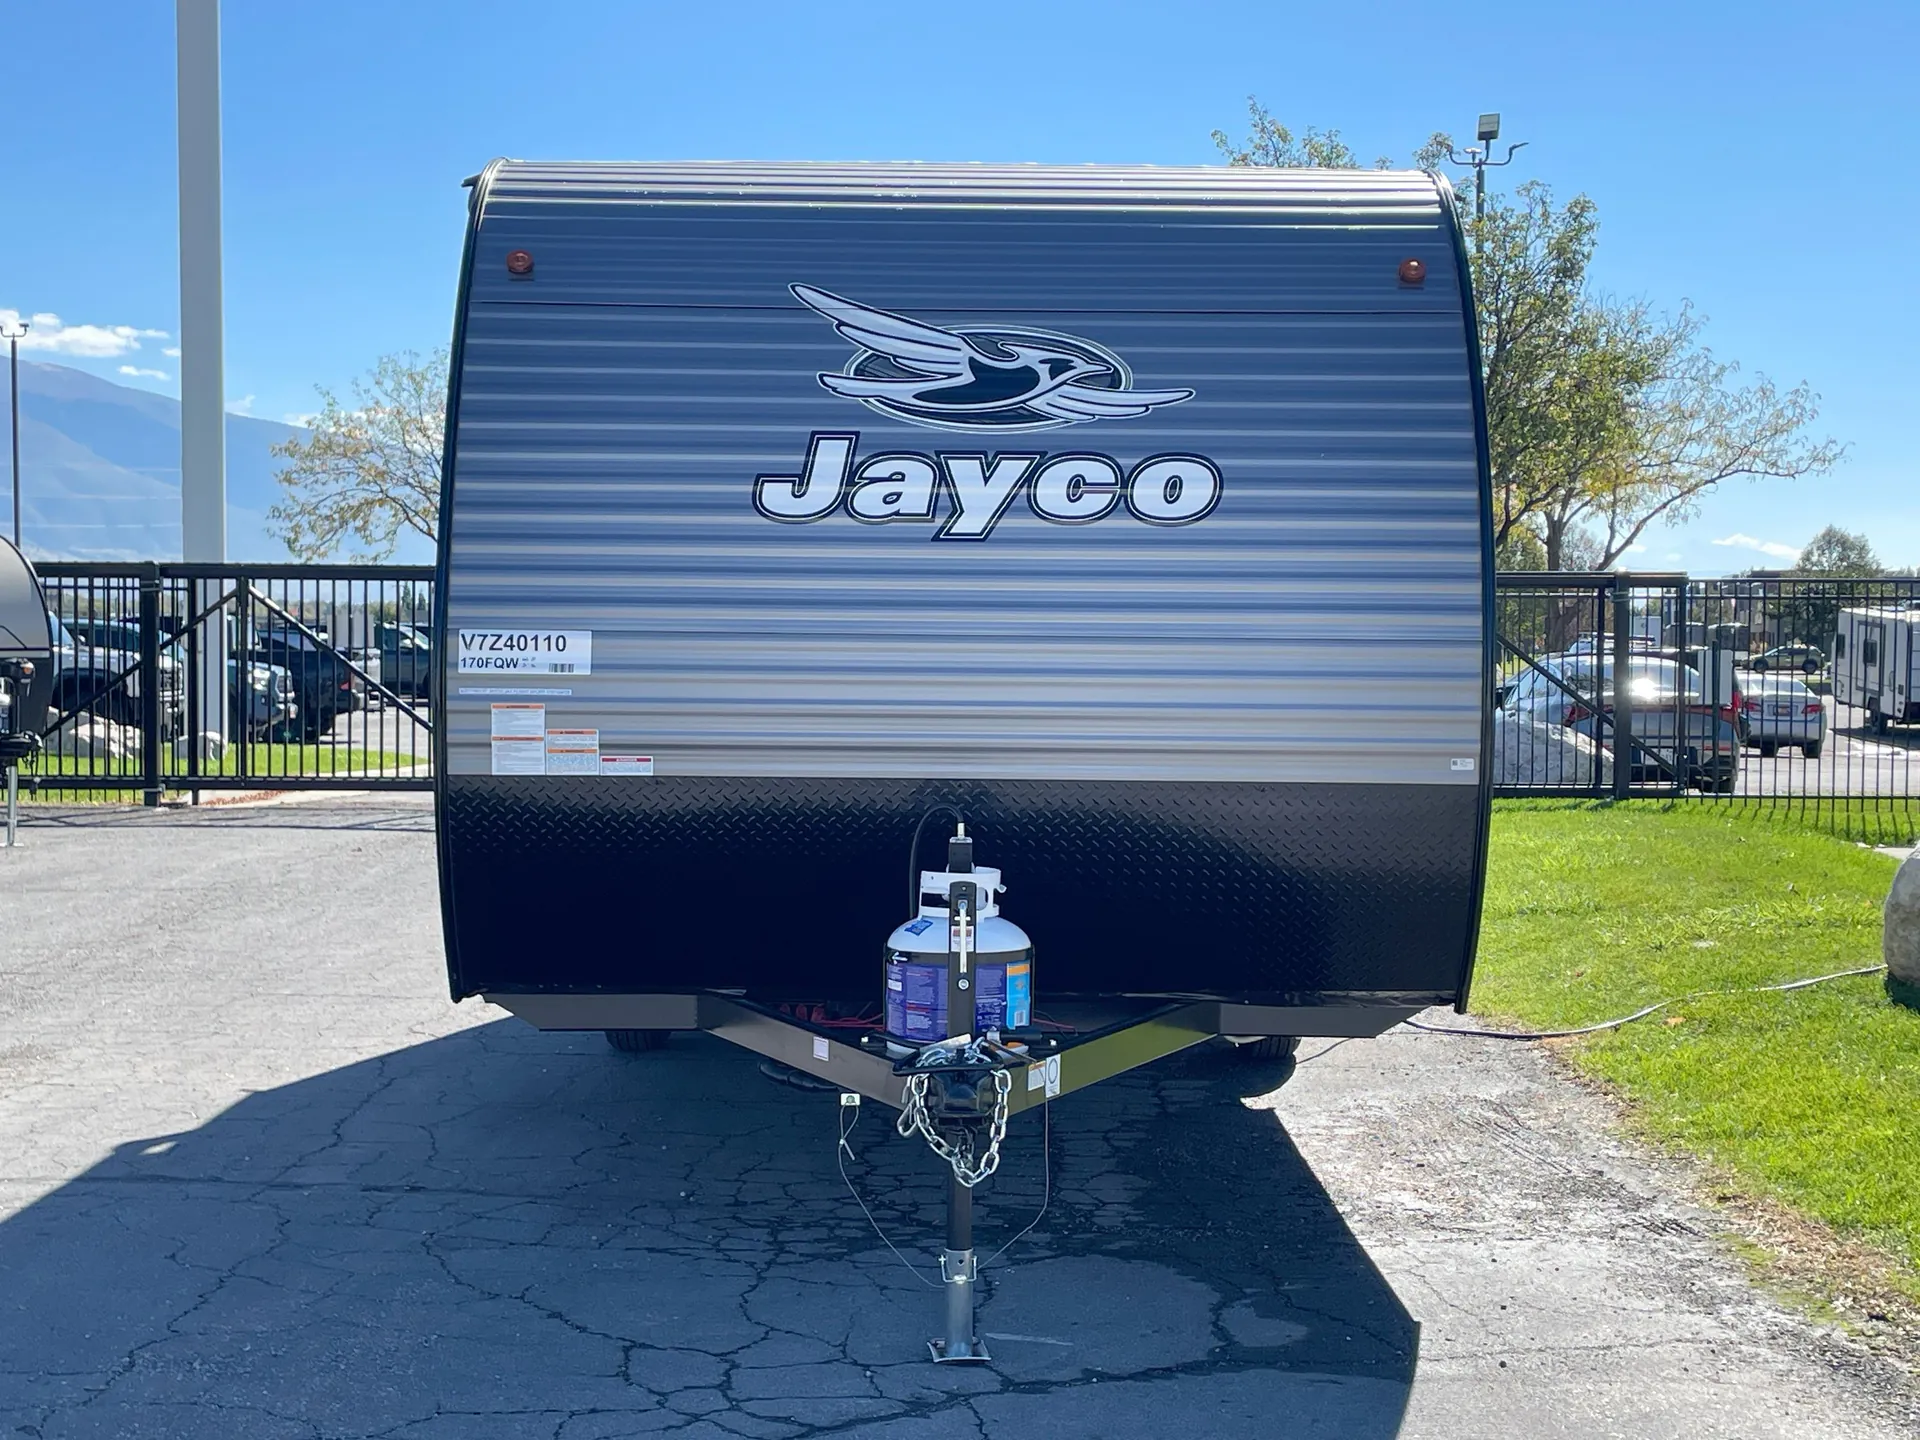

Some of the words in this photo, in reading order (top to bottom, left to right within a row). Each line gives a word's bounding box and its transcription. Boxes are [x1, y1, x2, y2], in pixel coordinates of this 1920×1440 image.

[752, 430, 1224, 542] Jayco
[461, 633, 567, 652] V7Z40110
[460, 657, 519, 669] 170FQW
